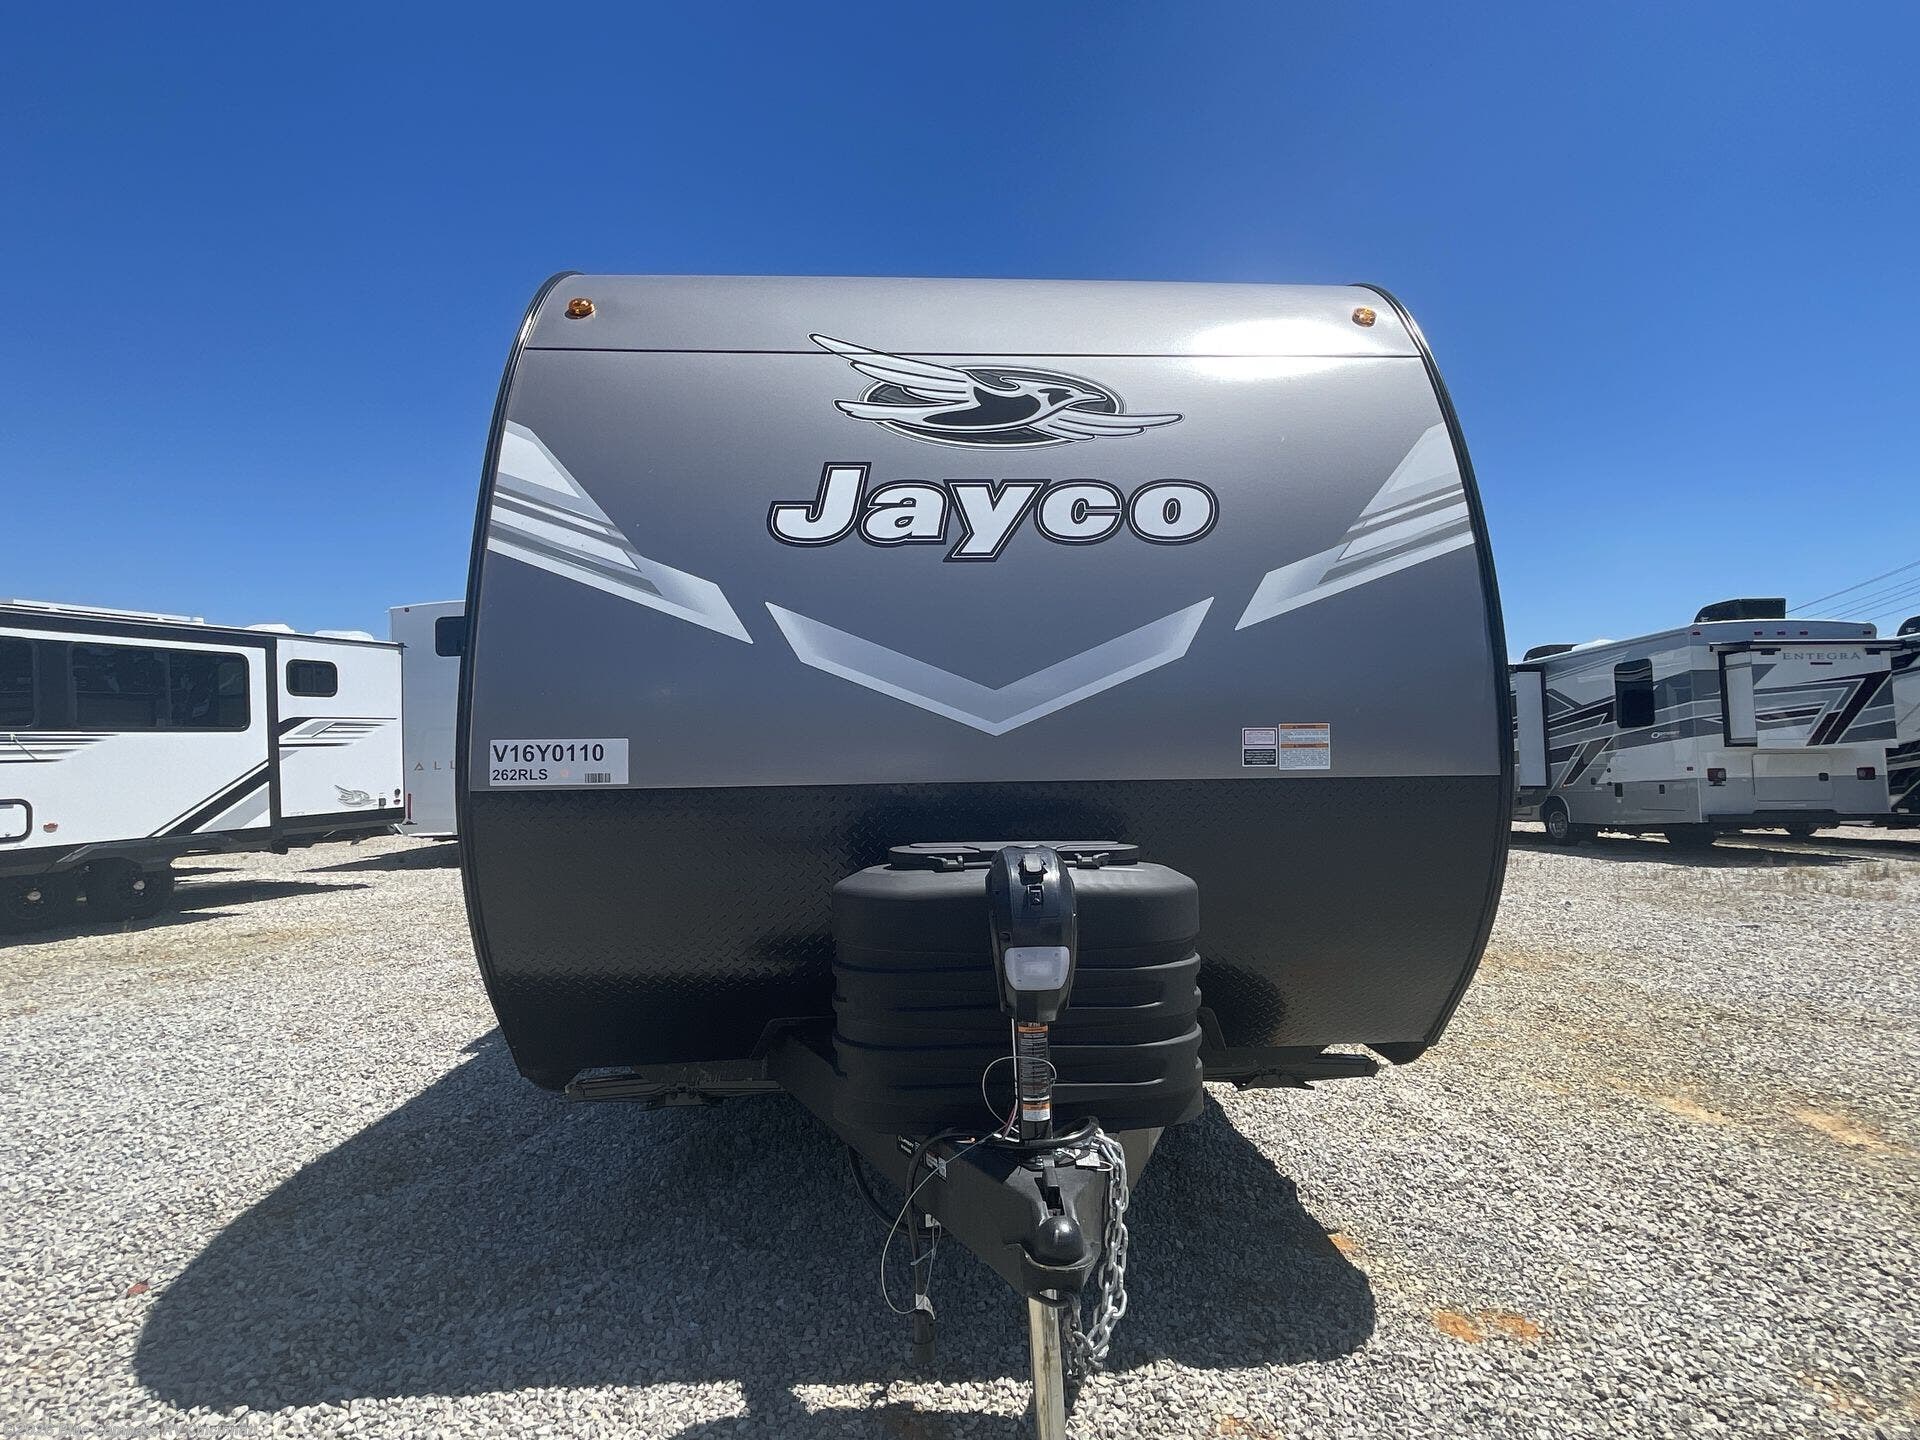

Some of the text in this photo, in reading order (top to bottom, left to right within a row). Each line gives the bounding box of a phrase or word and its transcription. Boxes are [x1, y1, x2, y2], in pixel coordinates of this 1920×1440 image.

[766, 461, 1219, 562] Jayco
[1782, 652, 1861, 660] ENTEGRA
[492, 743, 605, 763] V16Y0110
[492, 768, 548, 781] 262RLS
